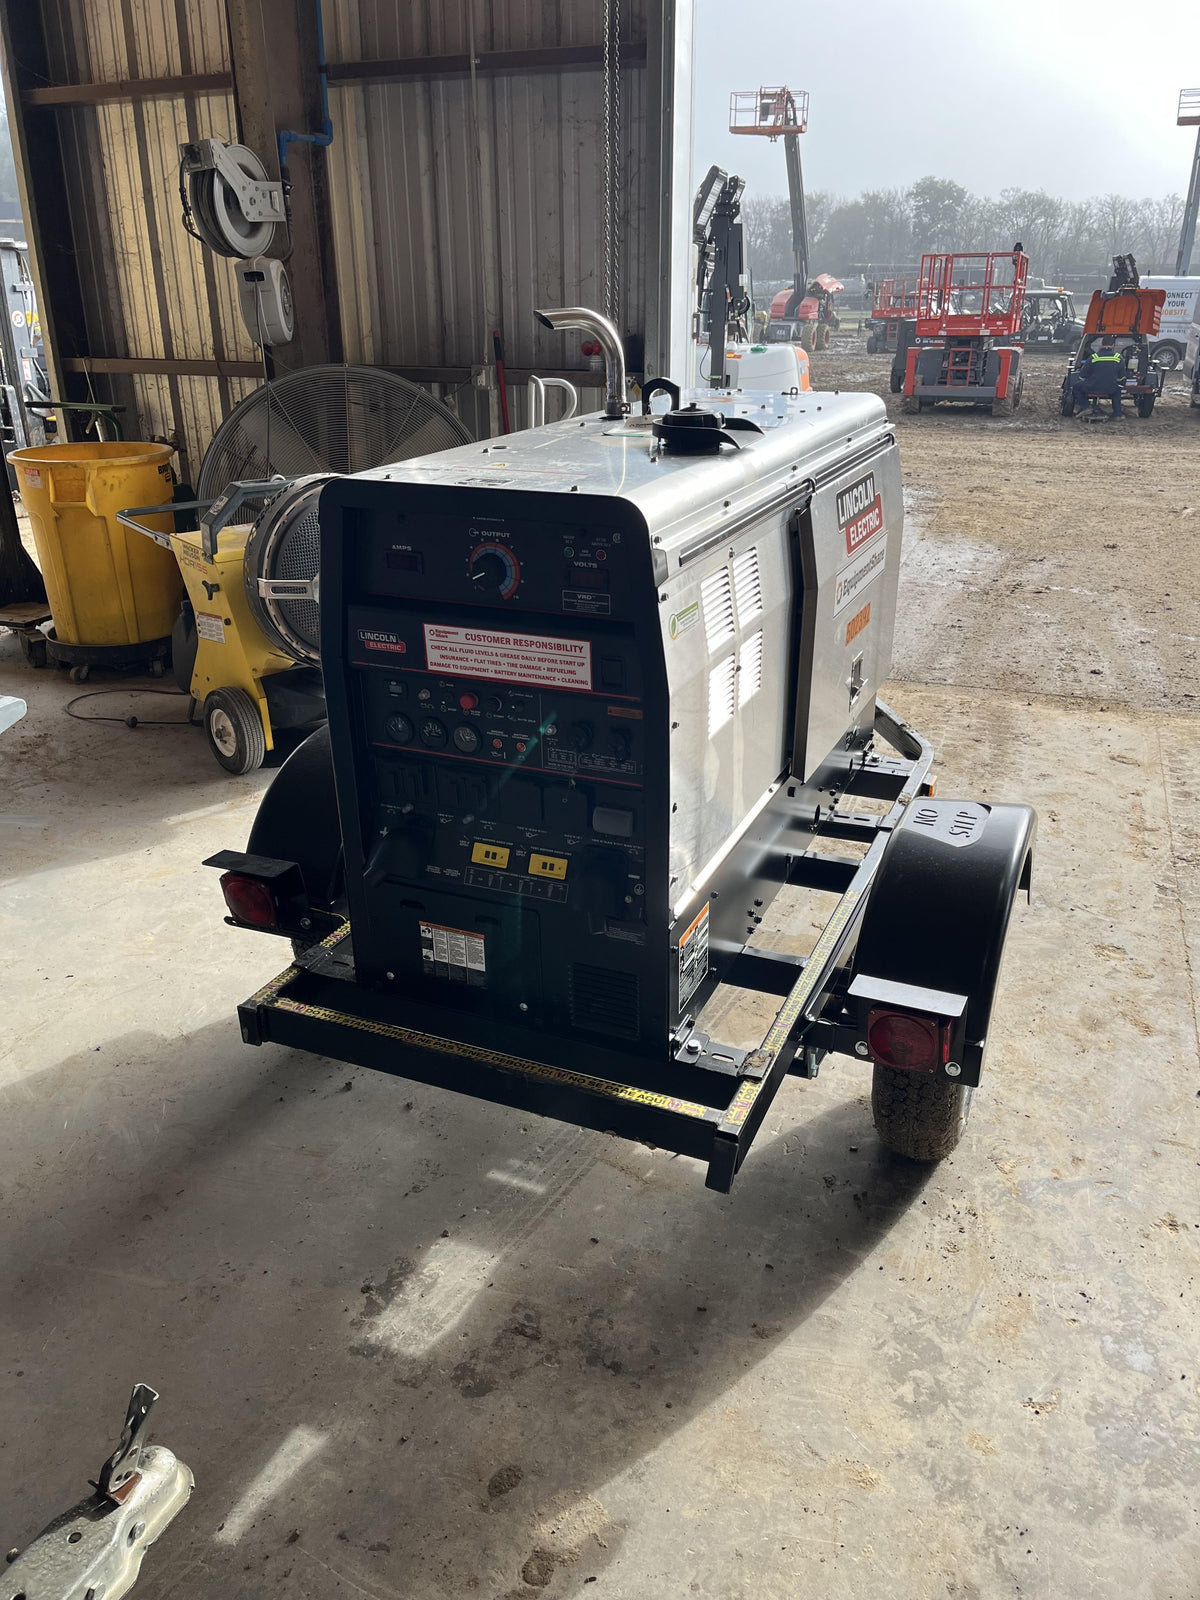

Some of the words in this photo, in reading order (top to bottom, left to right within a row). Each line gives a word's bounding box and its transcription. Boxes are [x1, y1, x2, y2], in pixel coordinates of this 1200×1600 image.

[1168, 300, 1185, 308] YOUR
[838, 476, 875, 525] LINCOLN
[481, 530, 511, 538] OUTPUT
[849, 507, 880, 547] ELECTRIC
[574, 561, 598, 569] VOLTS
[842, 548, 885, 598] EquipmentShare
[360, 631, 397, 643] LINCOLN
[369, 642, 402, 652] ELECTRIC
[465, 632, 511, 646] CUSTOMER
[513, 638, 584, 654] RESPONSIBILITY
[430, 644, 448, 652] CHECK
[500, 652, 520, 660] GREASE
[521, 654, 537, 662] DAILY
[538, 656, 558, 665] BEFORE
[559, 659, 576, 667] START
[577, 660, 585, 668] UP
[440, 654, 469, 663] INSURANCE
[486, 659, 502, 667] TIRES
[520, 662, 542, 672] DAMAGE
[546, 666, 576, 676] REFUELING
[430, 661, 451, 669] DAMAGE
[460, 664, 490, 674] EQUIPMENT
[494, 668, 517, 677] BATTERY
[518, 672, 556, 682] MAINTENANCE
[561, 677, 589, 686] CLEANING
[913, 808, 939, 826] NO
[797, 981, 810, 999] TENEZ
[305, 1006, 320, 1015] DO
[321, 1010, 343, 1023] NOT
[342, 1014, 378, 1031] STAND
[377, 1024, 404, 1038] HERE
[772, 1030, 786, 1048] HERE
[416, 1036, 433, 1046] NE
[433, 1041, 459, 1053] PAS
[457, 1046, 490, 1061] TENEZ
[490, 1054, 536, 1073] DEBOUT
[537, 1068, 554, 1077] ICI
[569, 1075, 586, 1086] NO
[587, 1079, 604, 1090] SE
[605, 1085, 636, 1097] PARE
[637, 1094, 666, 1104] AQUI
[744, 1088, 756, 1100] DO
